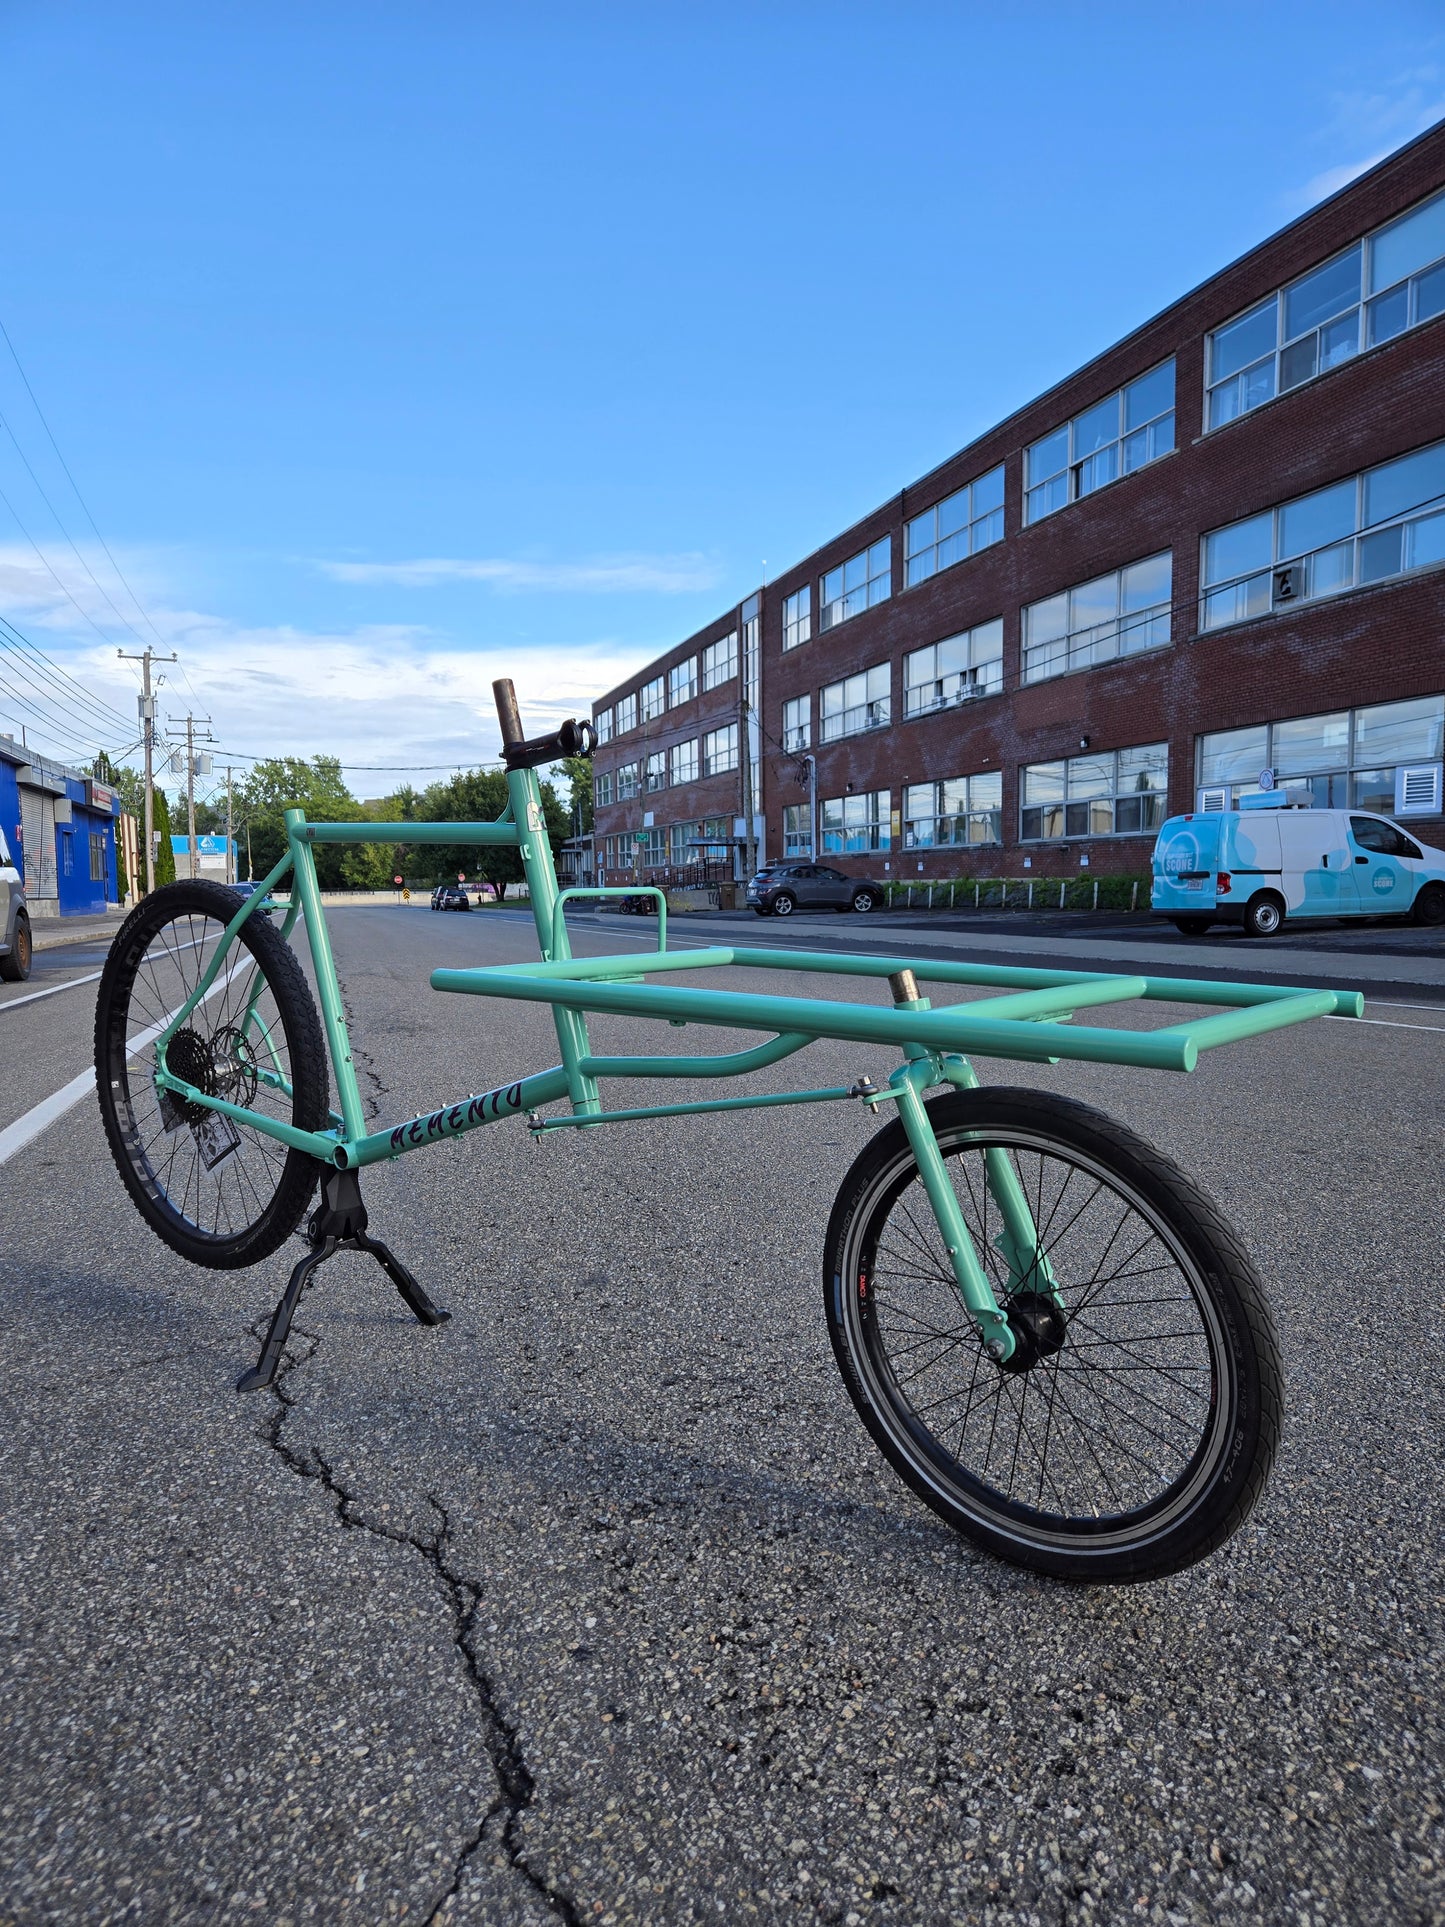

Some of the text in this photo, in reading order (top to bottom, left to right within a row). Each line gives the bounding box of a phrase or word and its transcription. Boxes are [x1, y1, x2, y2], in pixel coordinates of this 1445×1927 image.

[1166, 859, 1193, 871] SCONE
[118, 908, 146, 947] PIRELLI
[390, 1082, 522, 1149] MEMENTO
[835, 1178, 869, 1273] MARATHON PLUS
